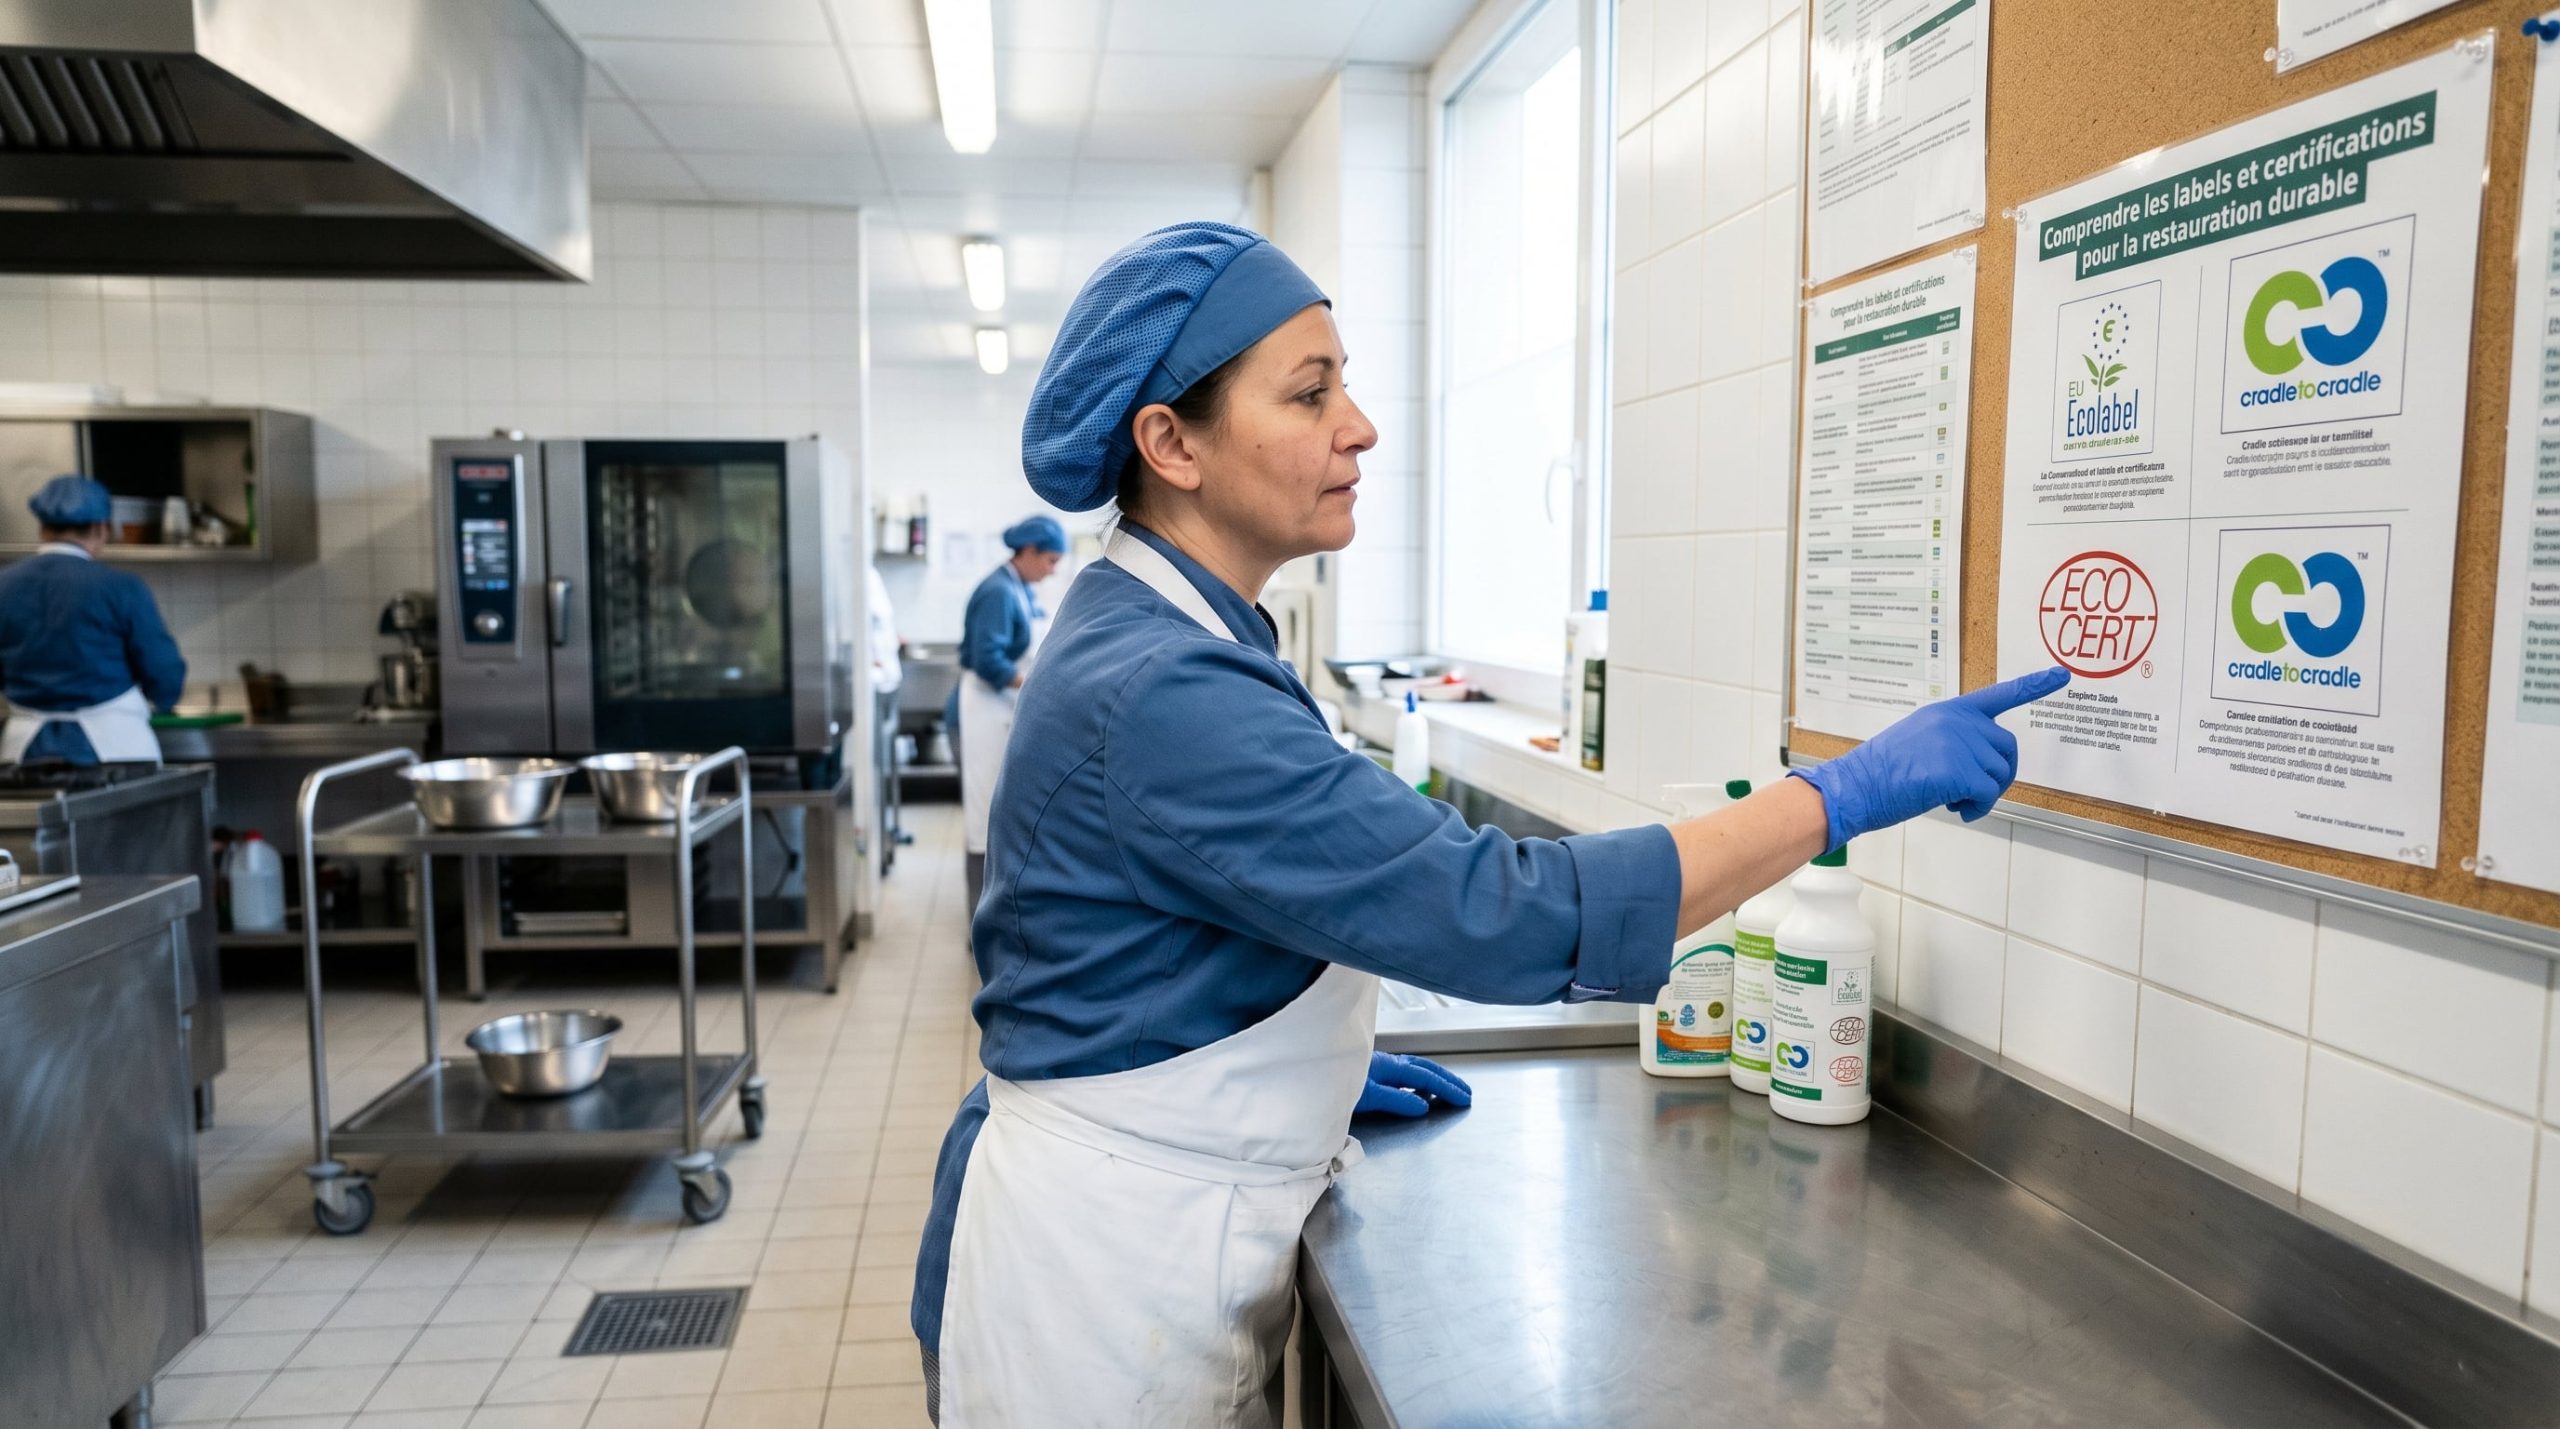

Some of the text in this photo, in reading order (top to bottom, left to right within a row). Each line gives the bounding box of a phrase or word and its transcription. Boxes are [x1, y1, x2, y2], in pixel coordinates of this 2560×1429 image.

[2044, 109, 2426, 250] Comprendre les labels et certifications
[2081, 168, 2359, 275] pour la restauration durable
[1902, 275, 1945, 297] certifications
[2067, 388, 2139, 437] Ecolabel
[2068, 381, 2084, 398] EU
[2060, 567, 2131, 613] ECO
[2057, 614, 2145, 661] CERT
